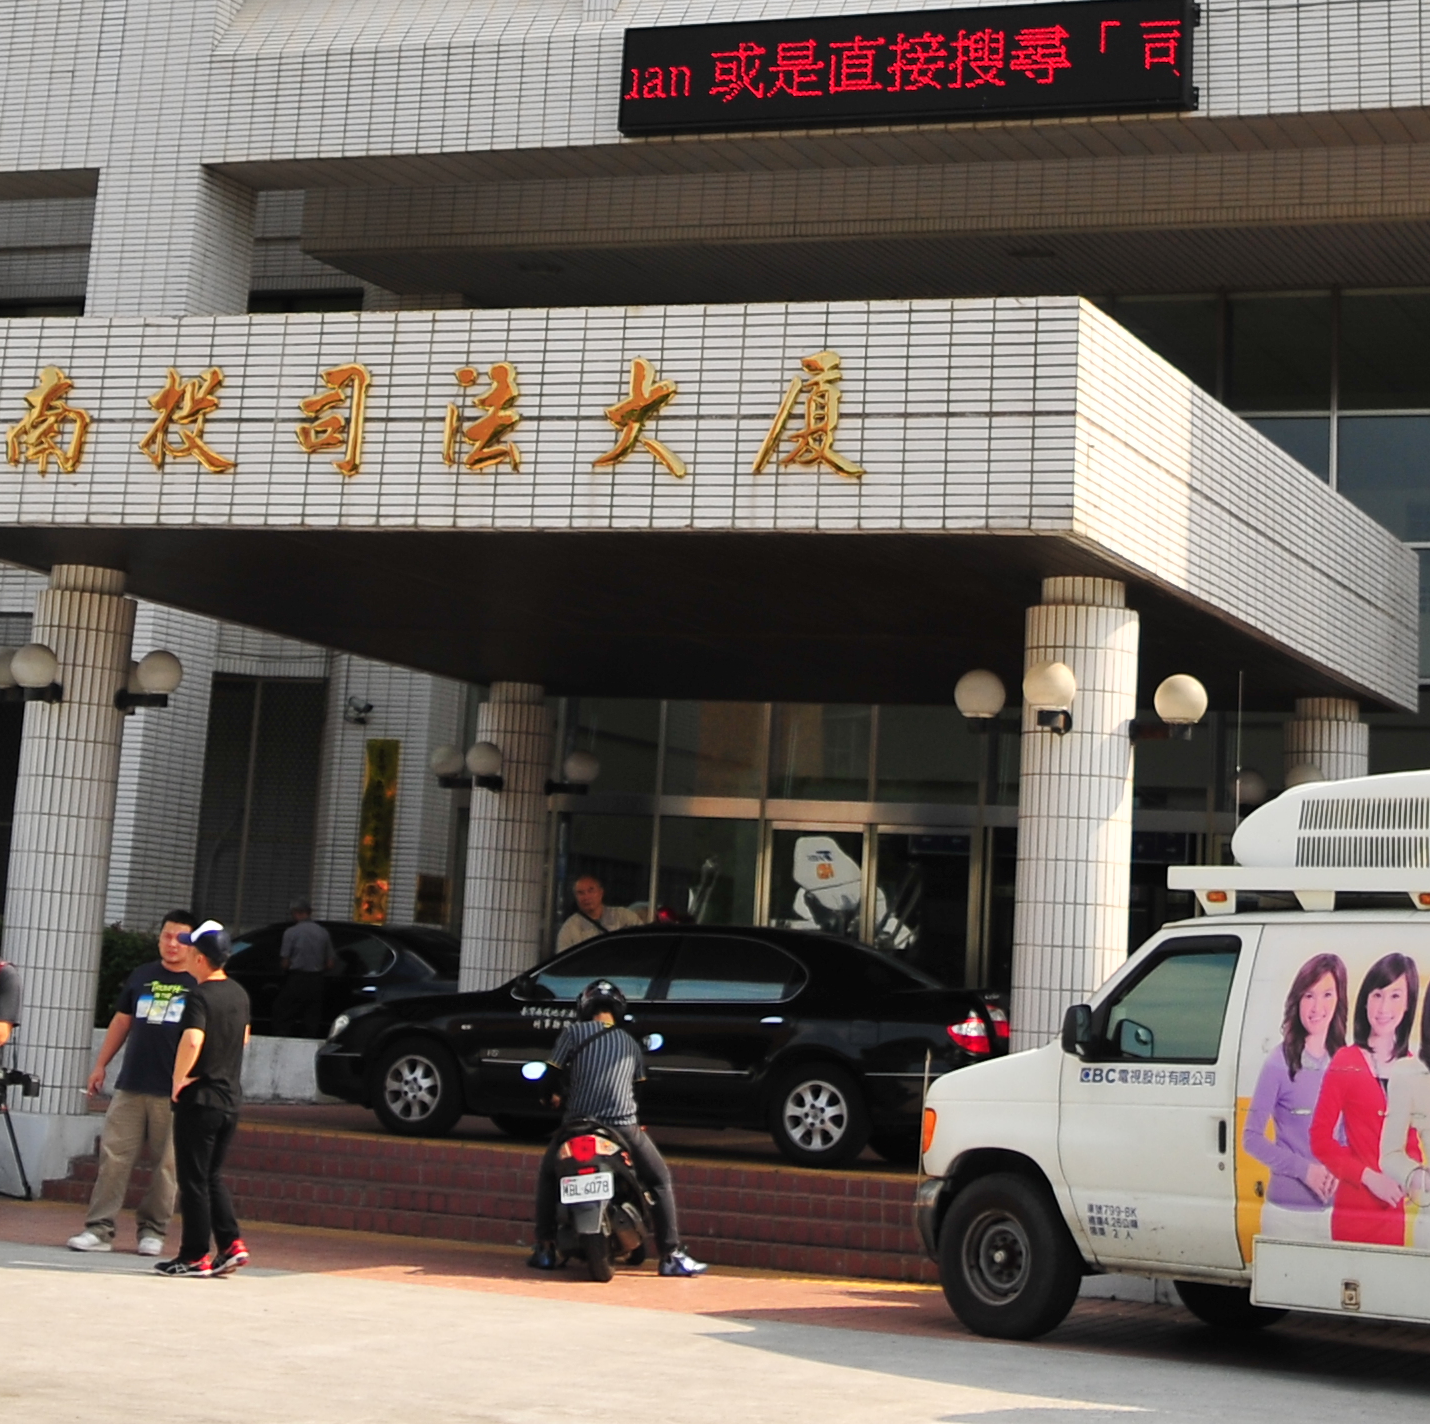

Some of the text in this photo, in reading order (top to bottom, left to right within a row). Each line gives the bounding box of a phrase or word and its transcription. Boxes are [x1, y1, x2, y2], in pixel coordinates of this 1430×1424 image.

[4, 350, 866, 479] 南投司法大廈
